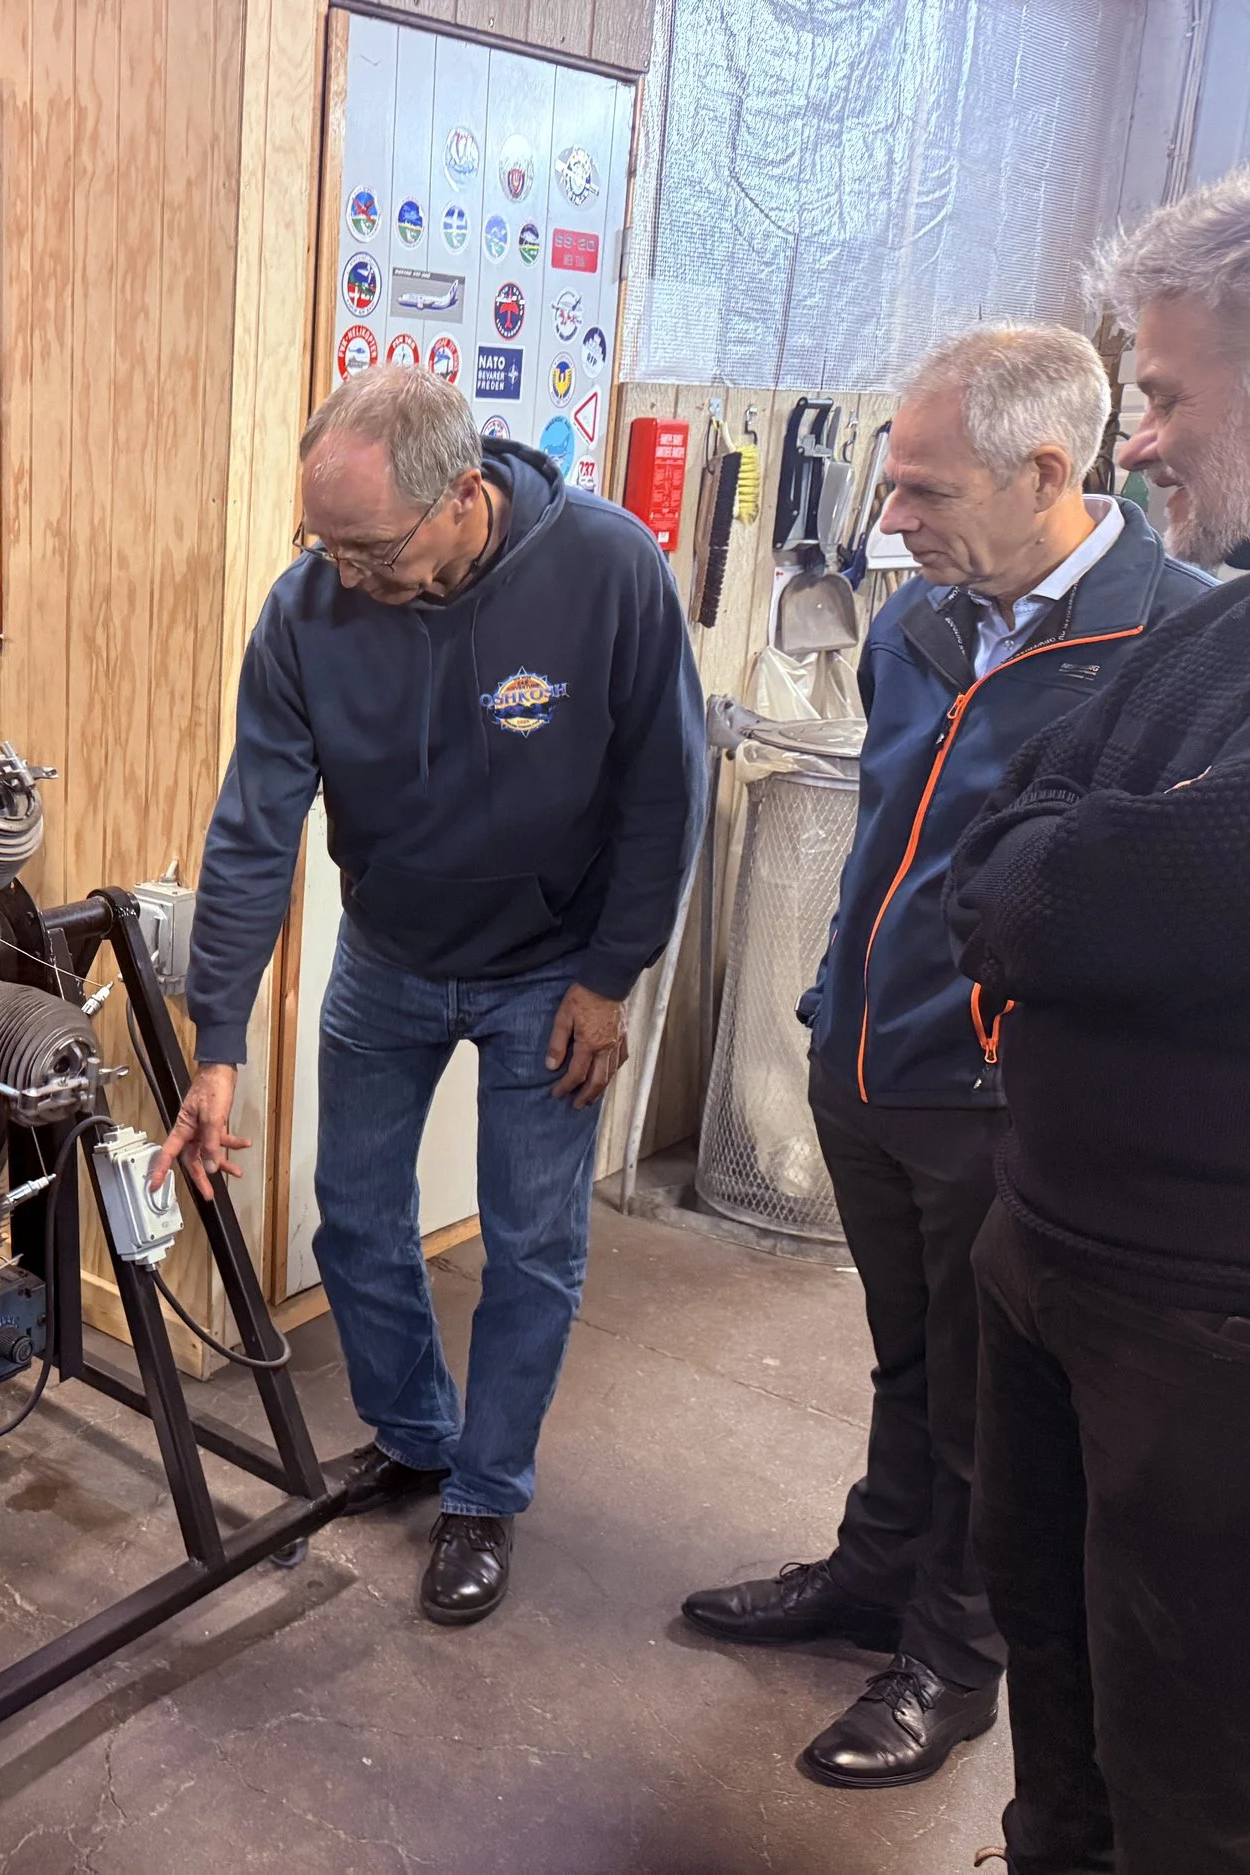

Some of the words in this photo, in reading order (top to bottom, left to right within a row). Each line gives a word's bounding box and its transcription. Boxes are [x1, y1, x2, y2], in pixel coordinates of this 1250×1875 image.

[478, 354, 506, 370] NATO
[478, 370, 505, 381] BEVARER
[477, 380, 505, 391] FREDEN
[579, 461, 595, 477] 737
[479, 682, 570, 709] OSHKOSH
